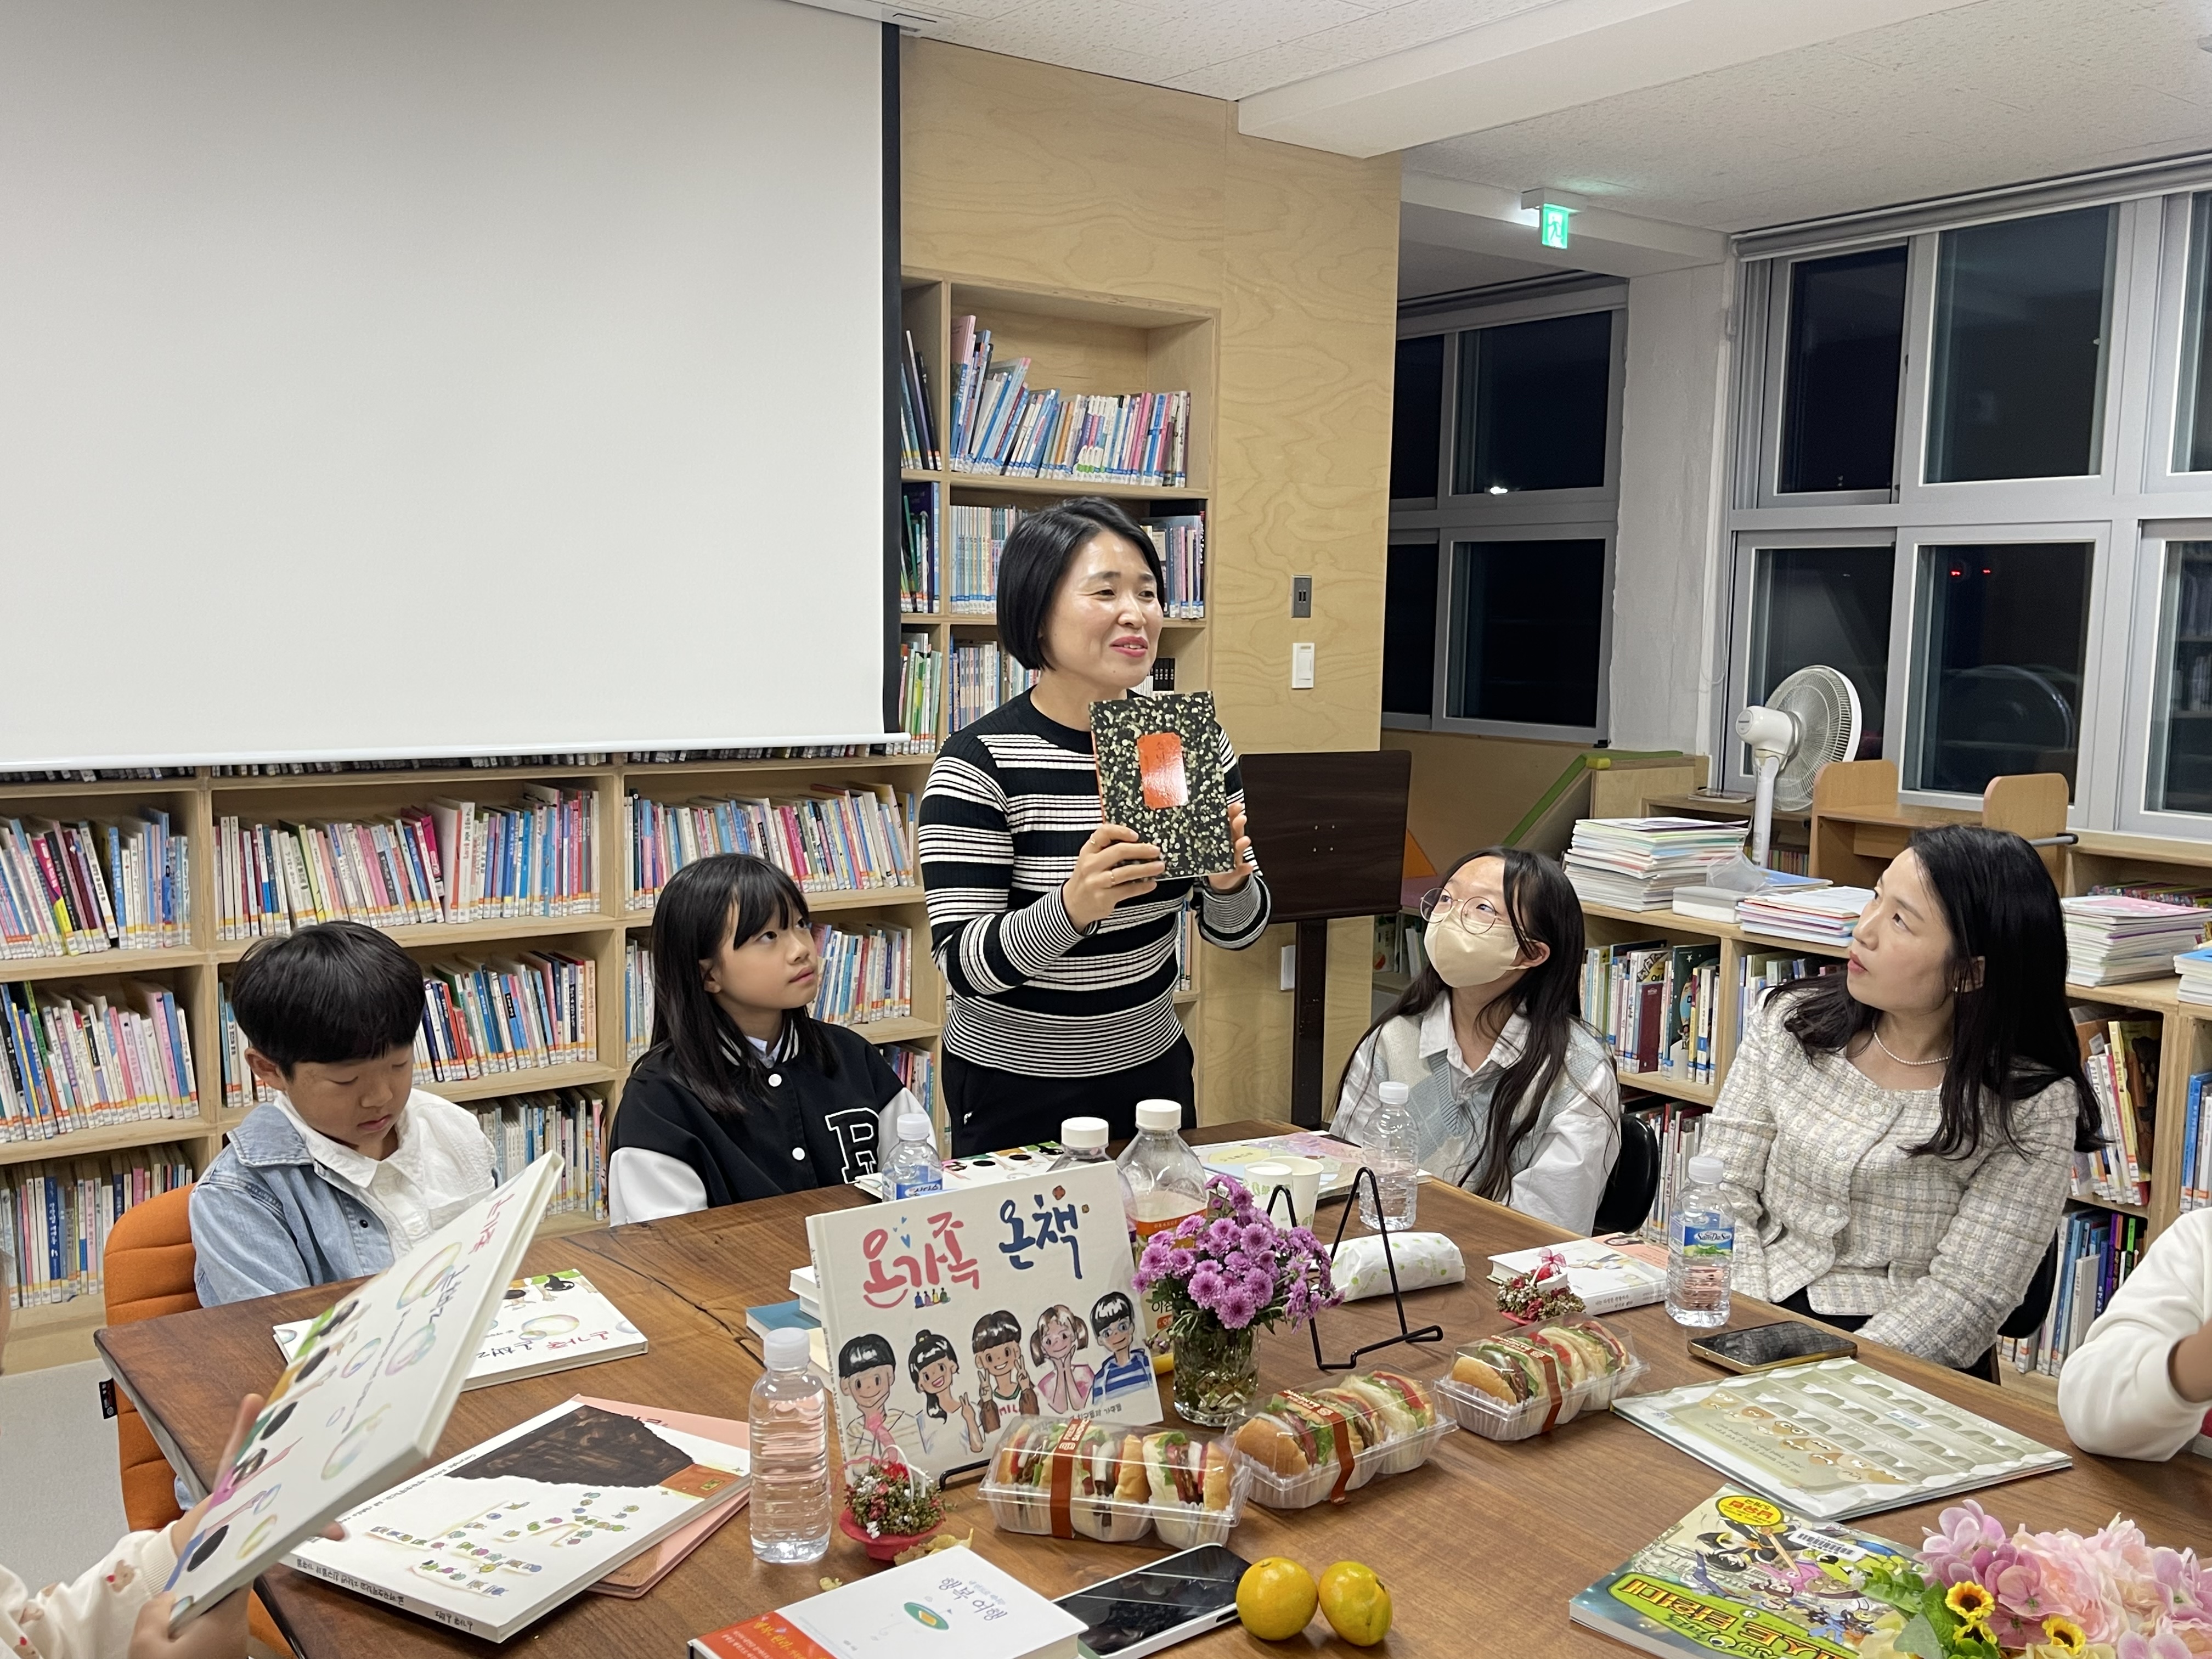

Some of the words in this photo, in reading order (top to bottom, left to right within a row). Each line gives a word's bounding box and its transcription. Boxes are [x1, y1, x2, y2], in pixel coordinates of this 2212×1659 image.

[825, 1108, 879, 1183] R
[863, 1212, 979, 1308] 온가족
[999, 1194, 1082, 1279] 온책
[939, 1577, 975, 1601] 행복
[972, 1599, 1008, 1622] 여행
